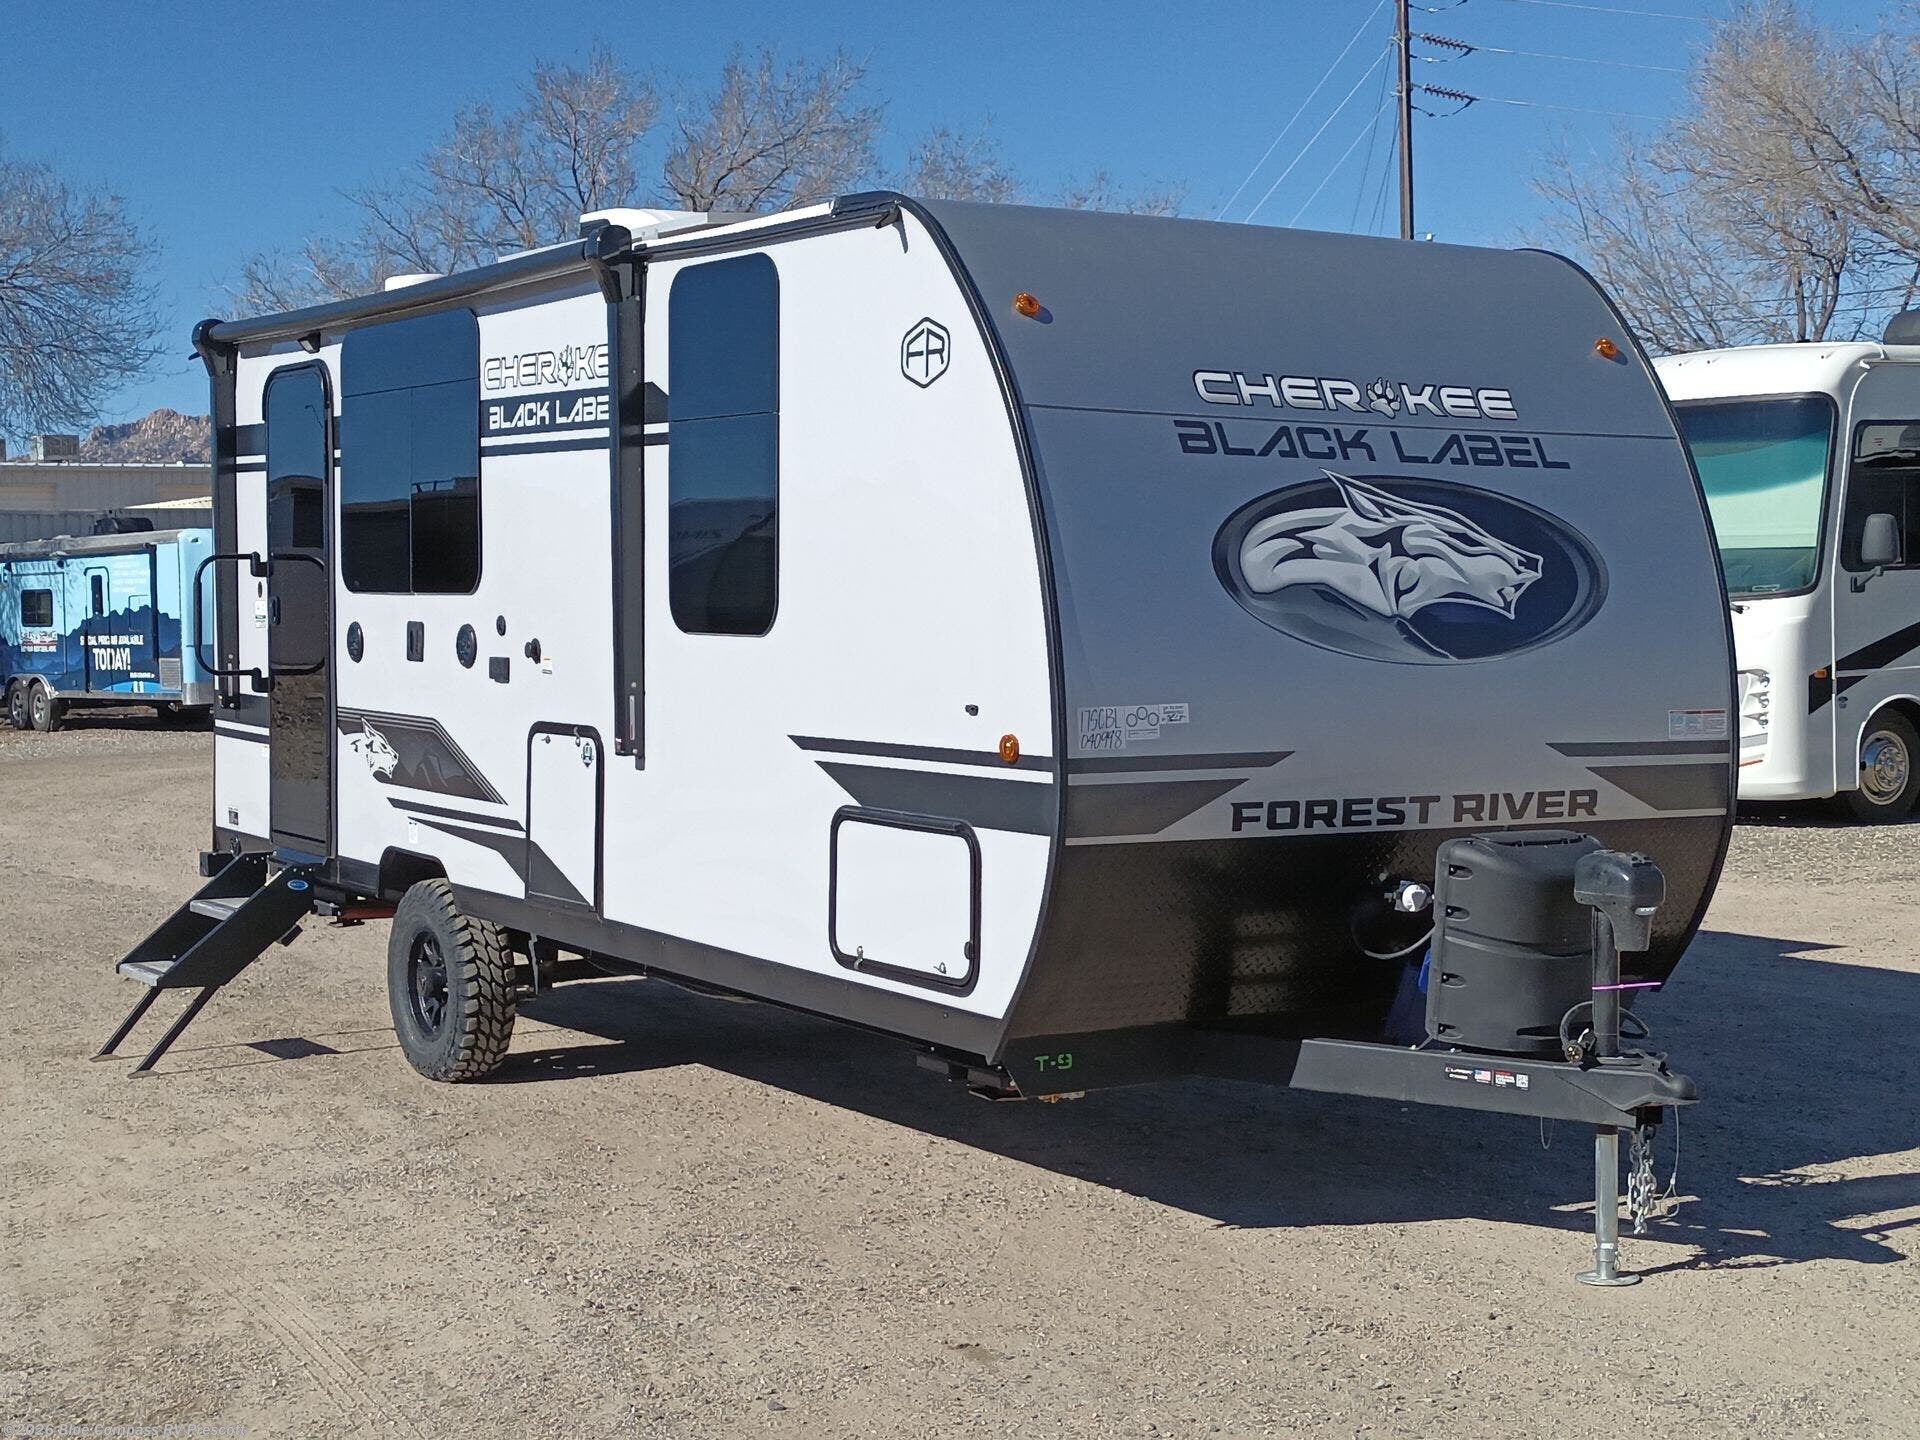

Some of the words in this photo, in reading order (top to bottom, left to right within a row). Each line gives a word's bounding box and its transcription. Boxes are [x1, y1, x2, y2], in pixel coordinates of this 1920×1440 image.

[484, 344, 609, 391] CHEROKE
[489, 401, 550, 430] BLACK
[555, 395, 609, 424] LABE
[1174, 420, 1377, 462] BLACK
[1389, 431, 1571, 470] LABEL
[92, 647, 131, 671] TODAY!
[1231, 795, 1441, 832] FOREST
[1452, 789, 1599, 823] RIVER
